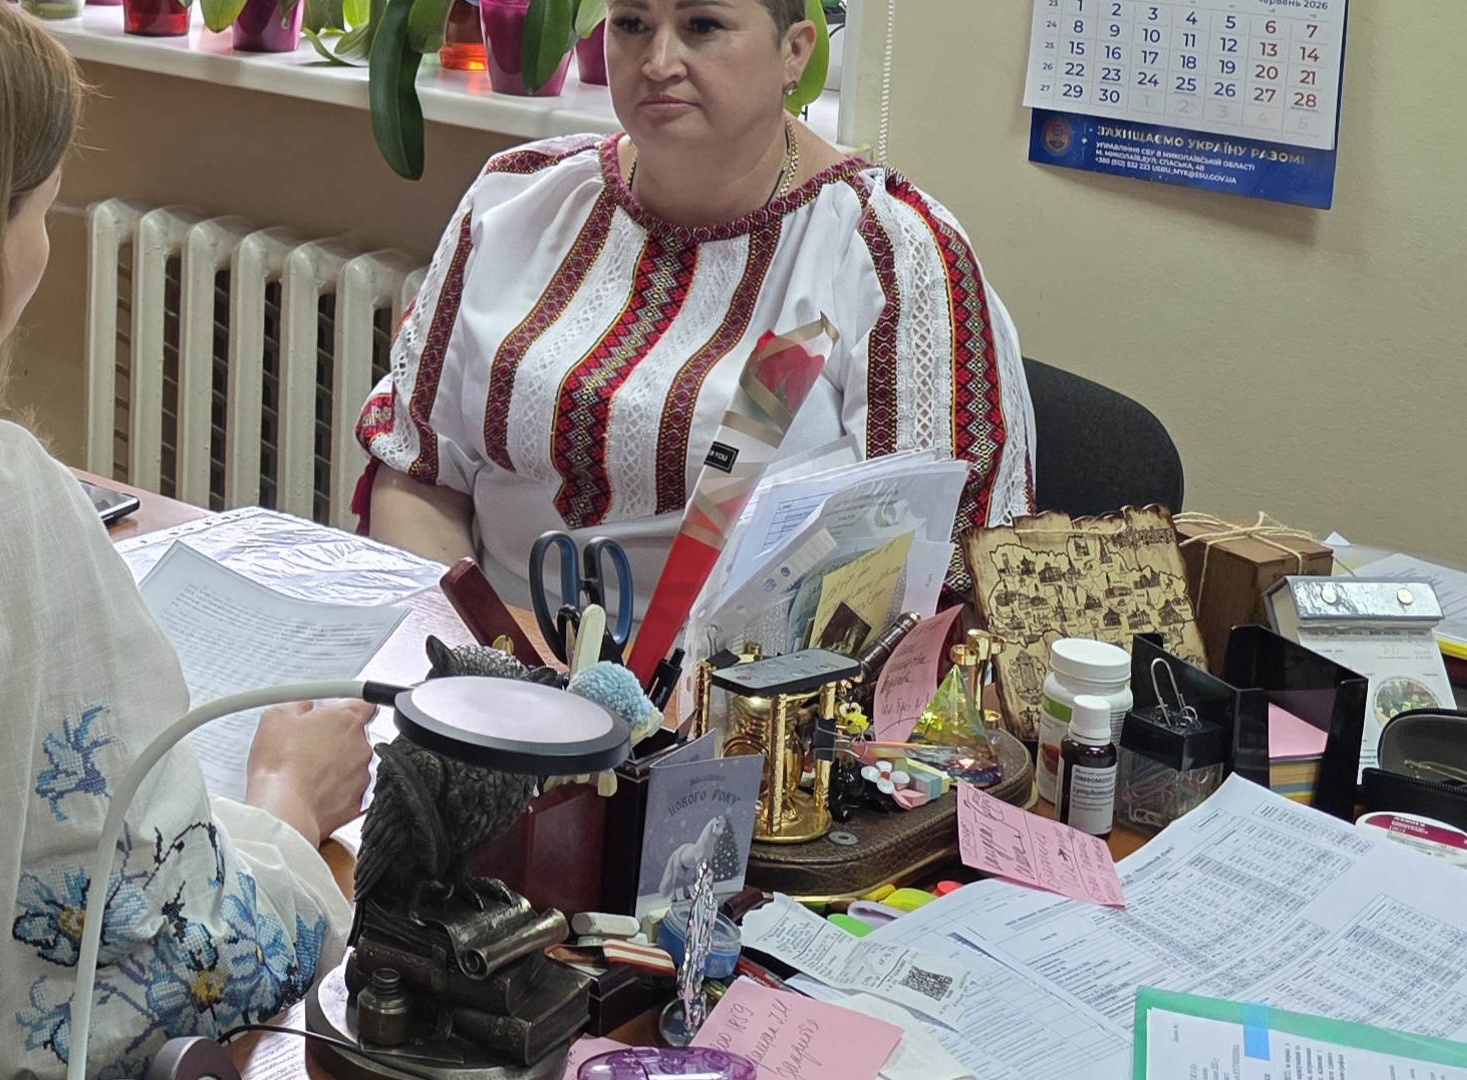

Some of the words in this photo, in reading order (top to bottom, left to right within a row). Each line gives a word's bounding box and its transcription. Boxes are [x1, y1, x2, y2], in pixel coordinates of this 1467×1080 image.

[1078, 0, 1082, 11] 1
[1112, 3, 1121, 16] 2
[1148, 7, 1158, 20] 3
[1186, 12, 1197, 25] 4
[1225, 15, 1235, 29] 5
[1265, 20, 1276, 34] 6
[1307, 24, 1318, 38] 7
[1303, 0, 1328, 10] 2026
[1074, 20, 1083, 33] 8
[1110, 24, 1120, 37] 9
[1143, 28, 1160, 43] 10
[1183, 33, 1195, 47] 11
[1220, 37, 1237, 52] 12
[1260, 42, 1277, 57] 13
[1300, 47, 1319, 62] 14
[1069, 41, 1085, 55] 15
[1105, 46, 1121, 60] 16
[1142, 50, 1158, 64] 17
[1180, 55, 1196, 69] 18
[1219, 60, 1235, 74] 19
[1255, 65, 1278, 80] 20
[1300, 70, 1315, 85] 21
[1063, 84, 1083, 98] 29
[1099, 88, 1120, 103] 30
[1065, 62, 1084, 77] 22
[1102, 67, 1121, 81] 23
[1138, 72, 1159, 87] 24
[1176, 77, 1196, 91] 25
[1214, 82, 1236, 97] 26
[1254, 87, 1276, 102] 27
[1294, 92, 1316, 108] 28
[1097, 125, 1184, 147] ЗАХИЩАЄМО
[1188, 138, 1247, 156] УКРАЇНУ
[1096, 141, 1140, 154] УПРАВЛІННЯ
[1141, 148, 1155, 156] СБУ
[1162, 151, 1221, 166] МИКОЛАЇВСЬКІЙ
[1222, 160, 1255, 171] ОБЛАСТІ
[1159, 159, 1194, 170] СПАСЬКА,
[714, 452, 728, 462] YOU
[668, 790, 707, 817] НОВОГО
[712, 789, 741, 807] РОКУ
